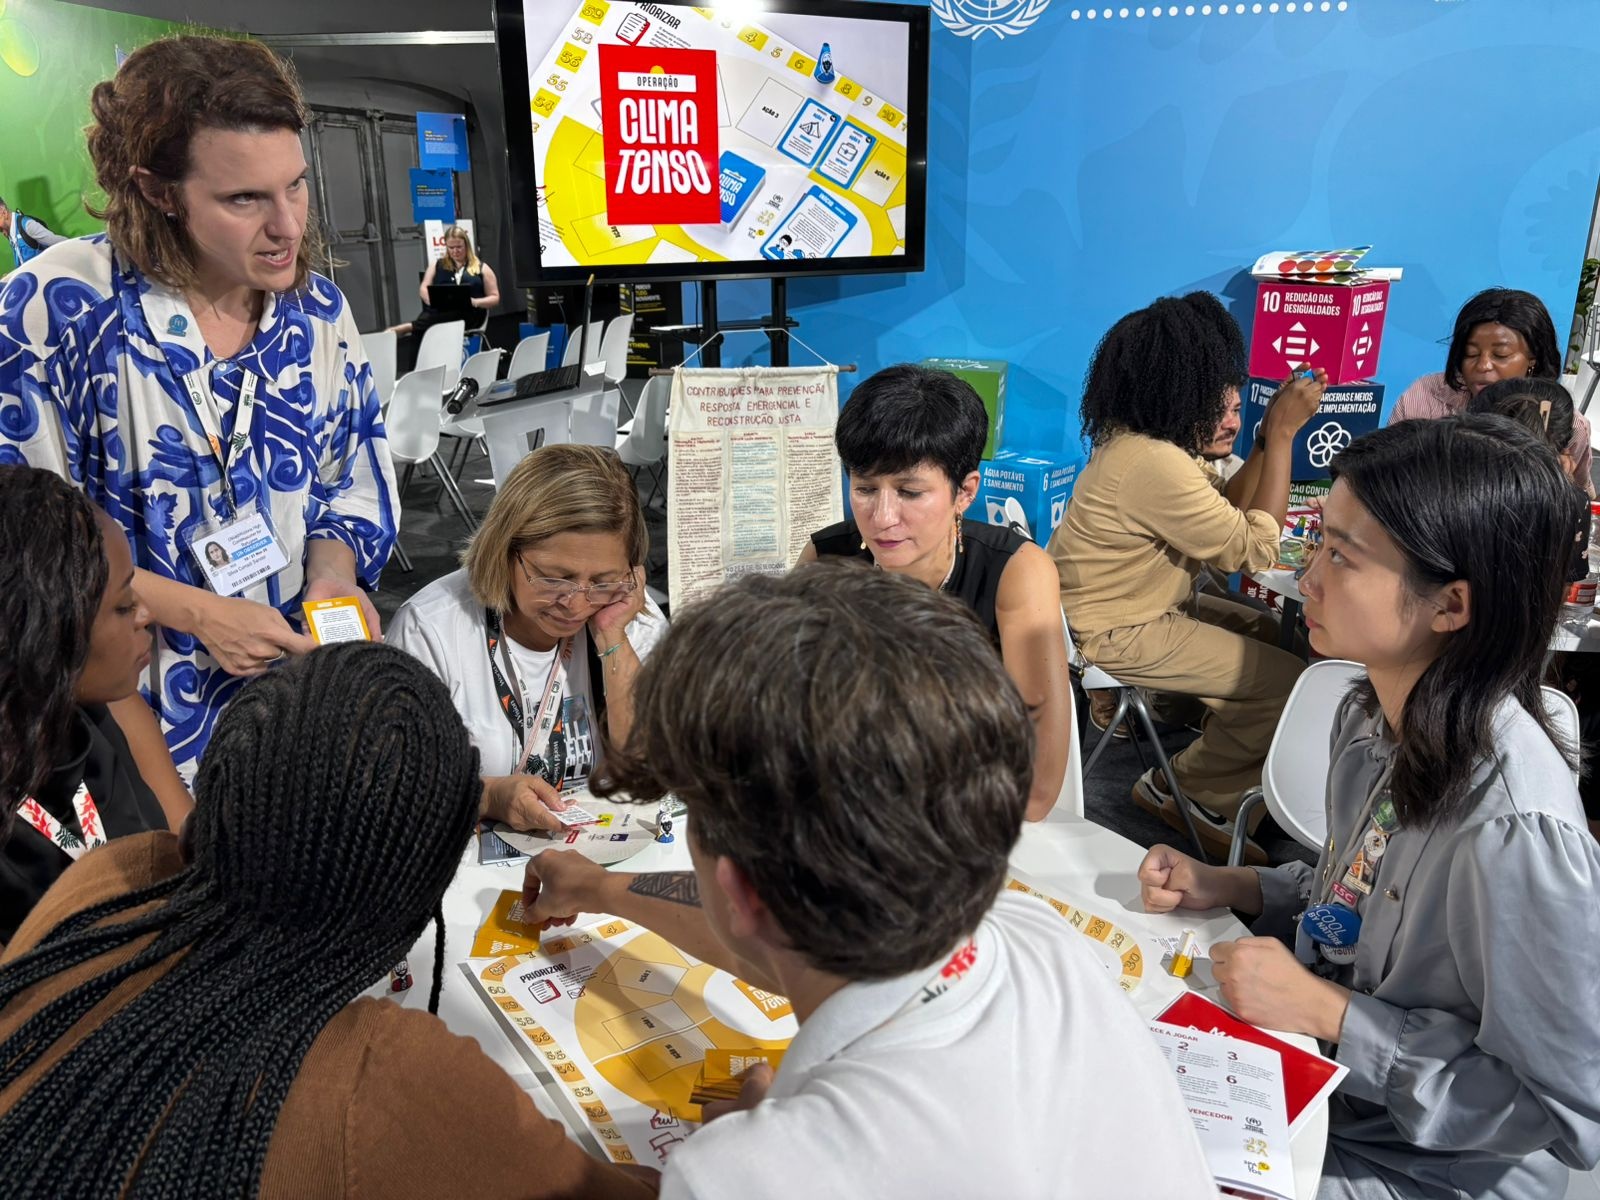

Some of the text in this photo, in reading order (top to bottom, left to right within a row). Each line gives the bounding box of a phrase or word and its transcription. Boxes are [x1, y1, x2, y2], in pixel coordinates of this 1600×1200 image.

[634, 1, 681, 30] PRIORIZAR
[571, 27, 594, 45] 58
[560, 50, 582, 68] 56
[794, 59, 806, 70] 6
[547, 73, 569, 92] 55
[637, 75, 678, 90] OPERAÇÃO
[840, 83, 853, 96] 8
[862, 96, 873, 108] 9
[619, 97, 698, 145] CLIMA
[1262, 291, 1281, 313] 10
[1284, 291, 1334, 304] REDUÇÃO DAS
[1284, 304, 1341, 316] DESIGUALDADES
[1352, 294, 1362, 317] 10
[754, 384, 774, 396] PARA
[1251, 383, 1259, 403] 17
[1320, 392, 1350, 402] ARCERIAS
[1354, 392, 1373, 401] MEIOS
[700, 398, 811, 413] RESPOSTA EMERGENCIAL E
[1323, 402, 1377, 414] IMPLEMENTAÇÃO
[1000, 470, 1025, 482] POTÁVEL
[1043, 472, 1049, 492] 6
[987, 480, 1024, 493] SANEAMENTO
[1305, 485, 1330, 496] CONTR
[1069, 910, 1084, 928] 27
[1315, 908, 1347, 937] COOL
[1090, 919, 1106, 938] 28
[1307, 911, 1343, 946] BY NATURE
[1110, 933, 1126, 949] 29
[1125, 953, 1141, 971] 30
[519, 963, 567, 984] PRIORIZAR
[487, 986, 506, 995] 60
[1173, 1033, 1198, 1042] JOGAR
[1178, 1041, 1189, 1051] 2
[1227, 1051, 1238, 1061] 3
[1176, 1065, 1187, 1074] 5
[1226, 1075, 1238, 1084] 6
[1188, 1106, 1233, 1121] VENCEDOR
